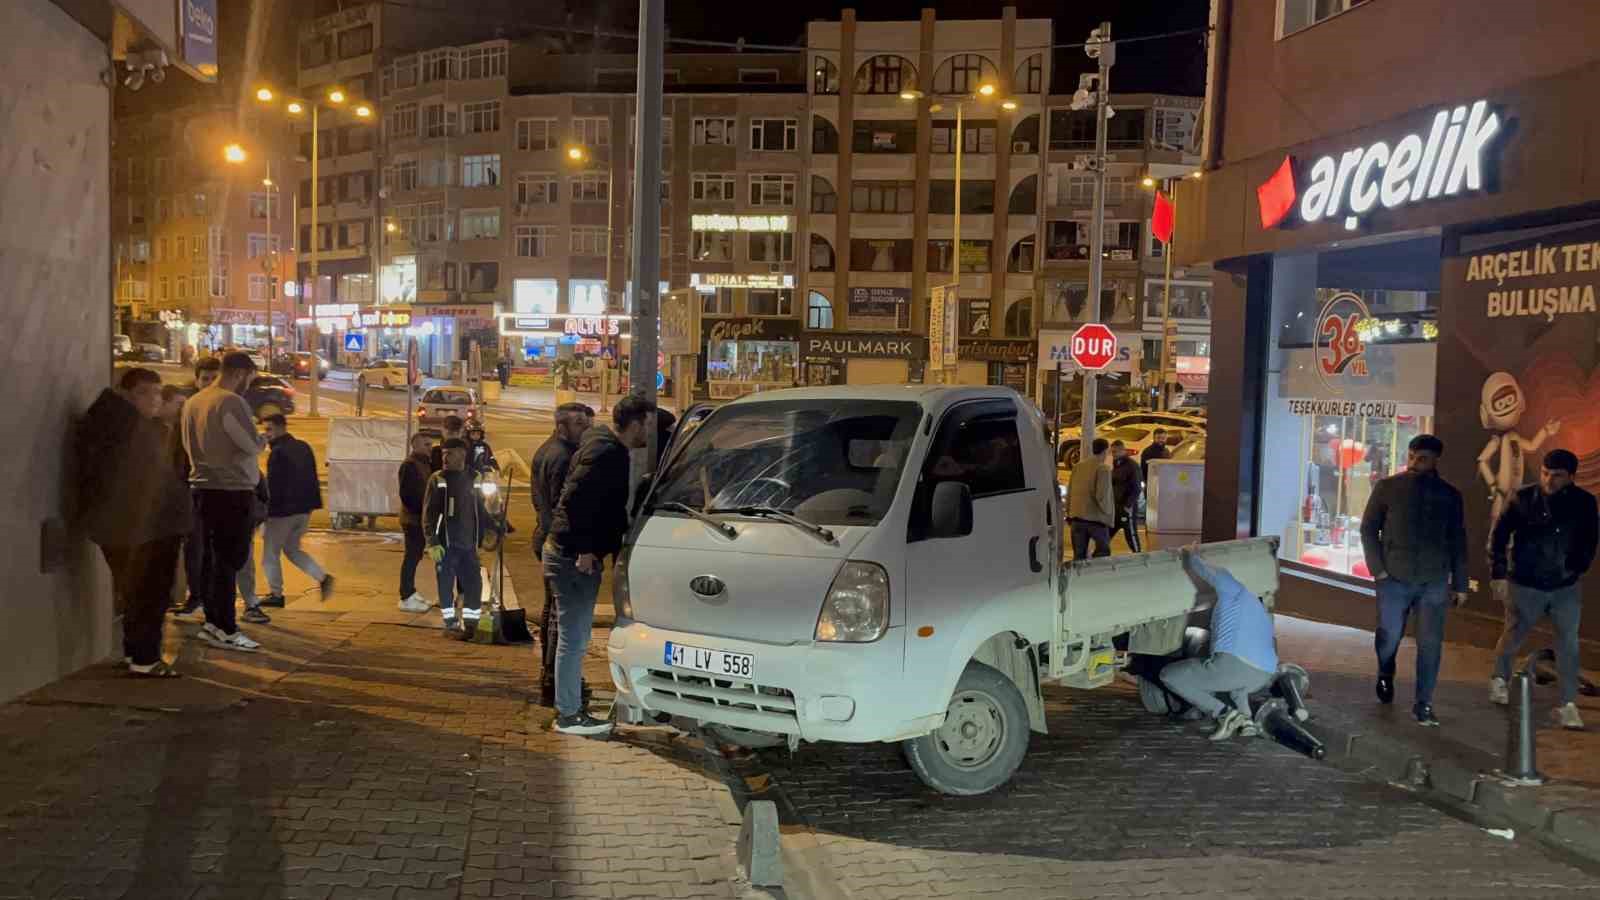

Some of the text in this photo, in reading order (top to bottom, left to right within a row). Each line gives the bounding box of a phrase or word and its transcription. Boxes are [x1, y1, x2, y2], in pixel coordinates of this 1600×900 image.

[1300, 99, 1500, 231] arçelik
[1465, 242, 1558, 286] ARÇELİK
[564, 317, 620, 336] ALTUS
[809, 339, 912, 355] PAULMARK
[1074, 337, 1113, 357] DUR
[694, 578, 720, 595] KIA
[672, 647, 750, 675] 41 LV 558
